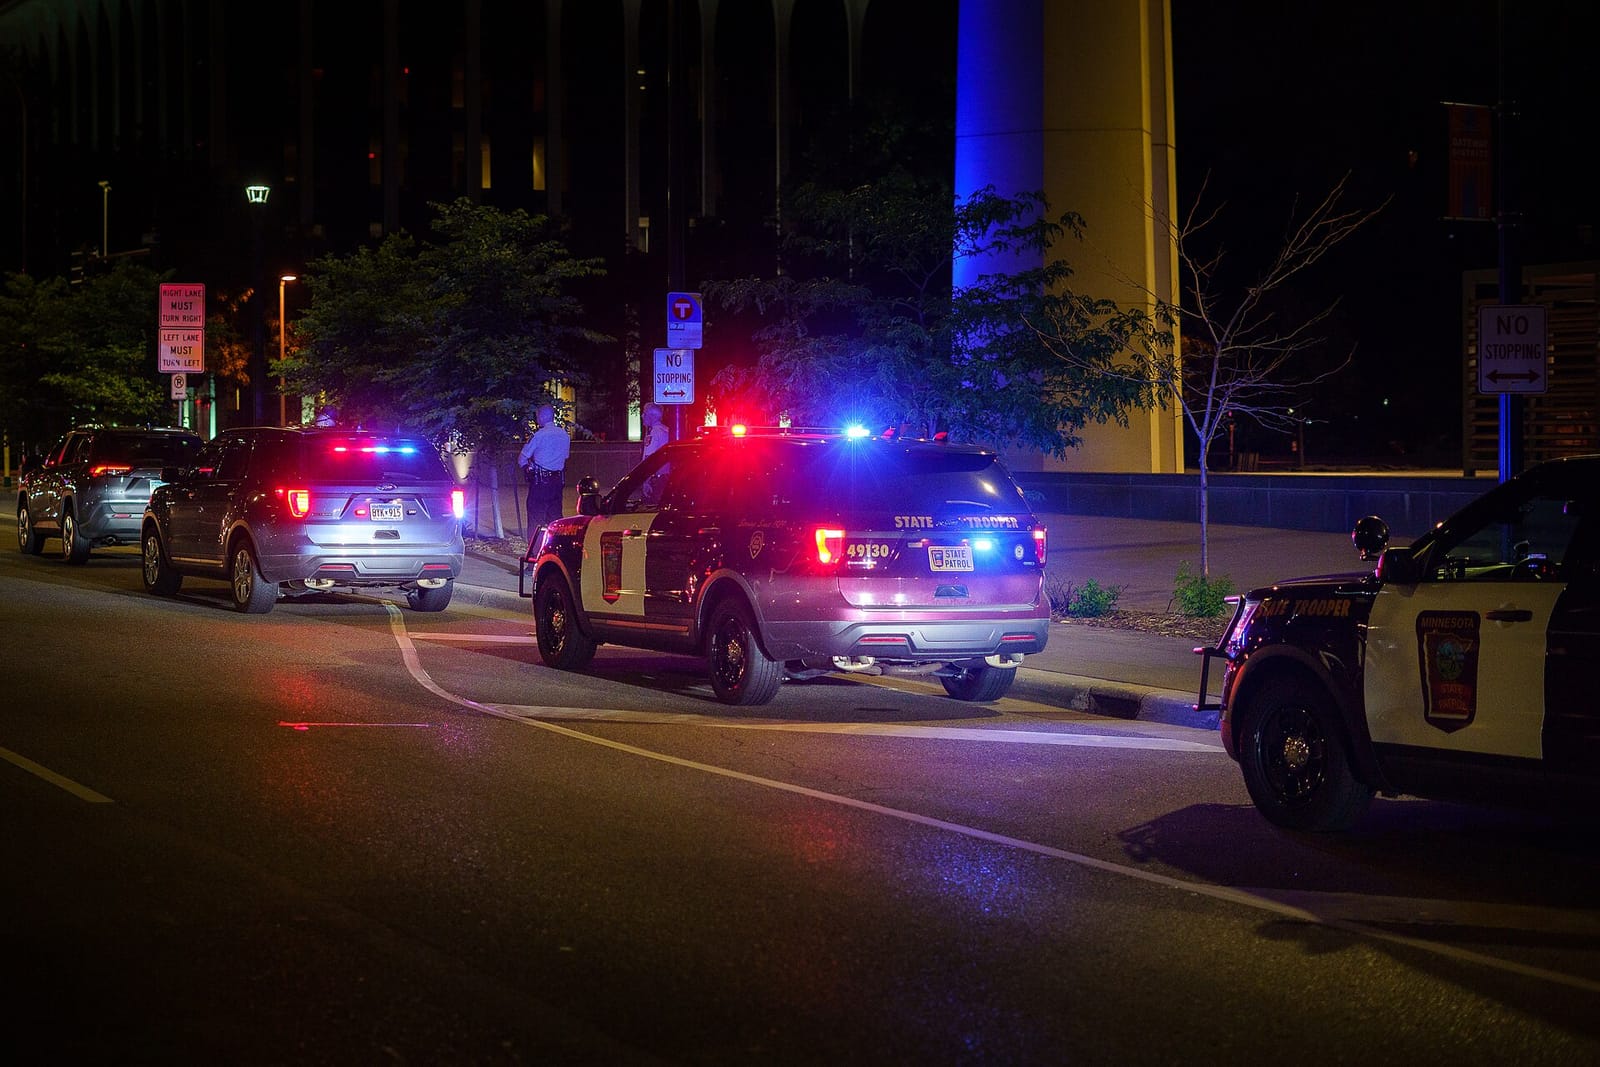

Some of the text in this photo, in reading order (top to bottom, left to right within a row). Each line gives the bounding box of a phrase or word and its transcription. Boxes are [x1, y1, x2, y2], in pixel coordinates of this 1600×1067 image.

[163, 289, 201, 297] RIGHT LANE
[171, 302, 192, 310] MUST
[1496, 315, 1528, 335] NO
[170, 346, 192, 354] MUST
[1485, 344, 1541, 360] STOPPING
[666, 354, 682, 367] NO
[656, 373, 692, 384] STOPPING
[894, 515, 1019, 529] STATE TROOPER
[847, 544, 890, 558] 49130
[945, 550, 966, 558] STATE
[945, 559, 971, 568] PATROL
[1292, 598, 1351, 617] TROOPER
[1420, 616, 1474, 630] MINNESOTA
